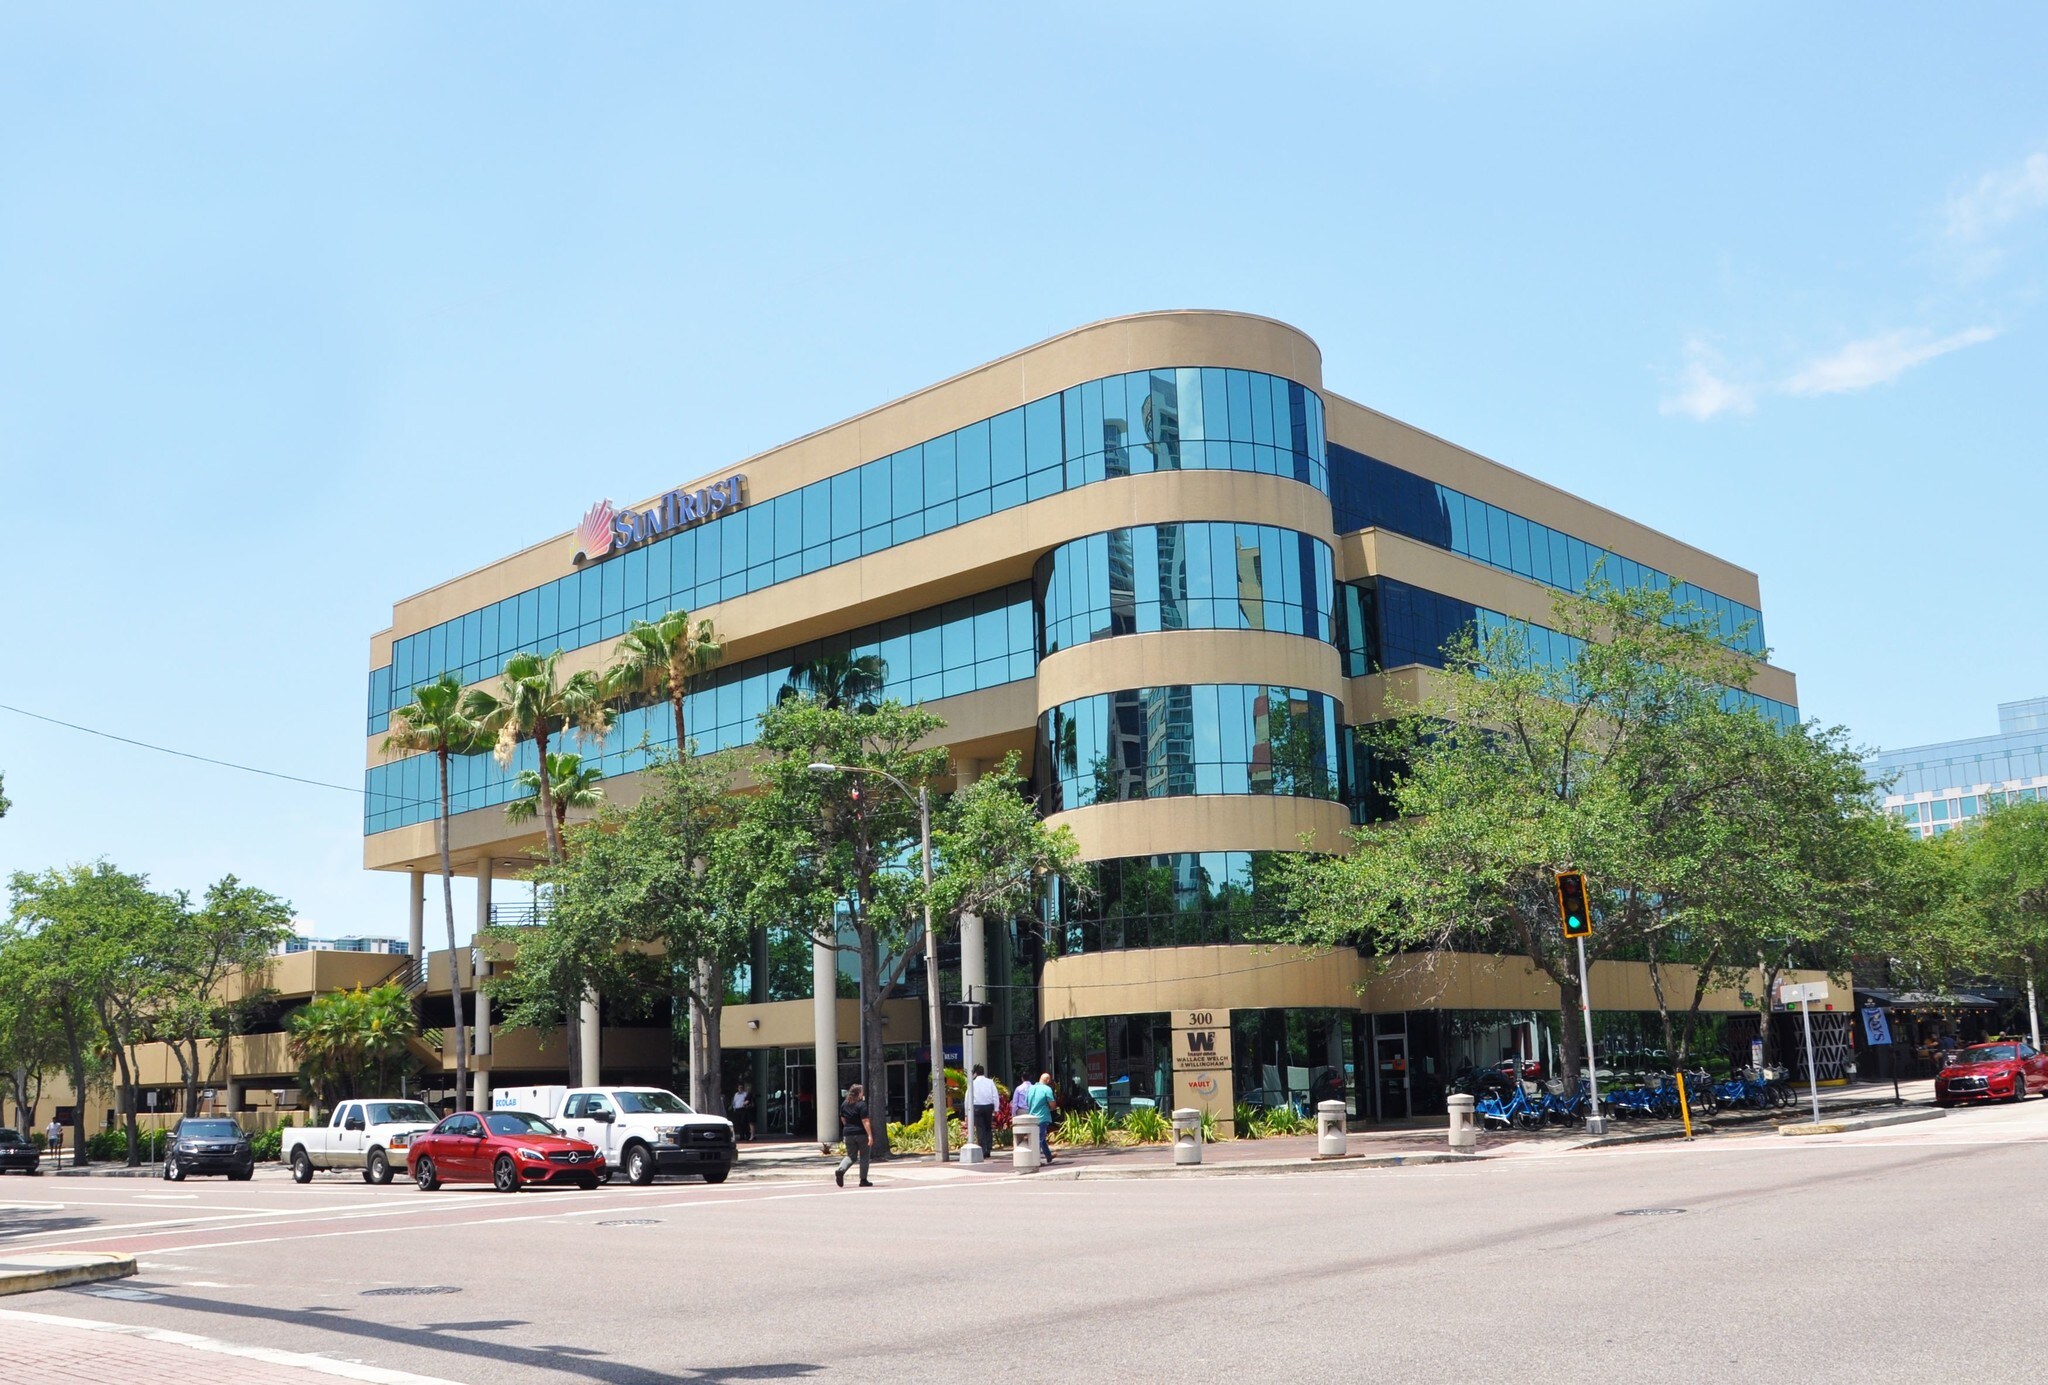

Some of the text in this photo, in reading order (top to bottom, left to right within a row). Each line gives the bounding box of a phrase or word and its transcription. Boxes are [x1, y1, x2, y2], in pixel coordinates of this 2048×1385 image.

[615, 474, 748, 549] SUNTRUST
[1189, 1012, 1213, 1025] 300
[1188, 1080, 1211, 1088] VAULT
[495, 1098, 517, 1107] ECOLAB
